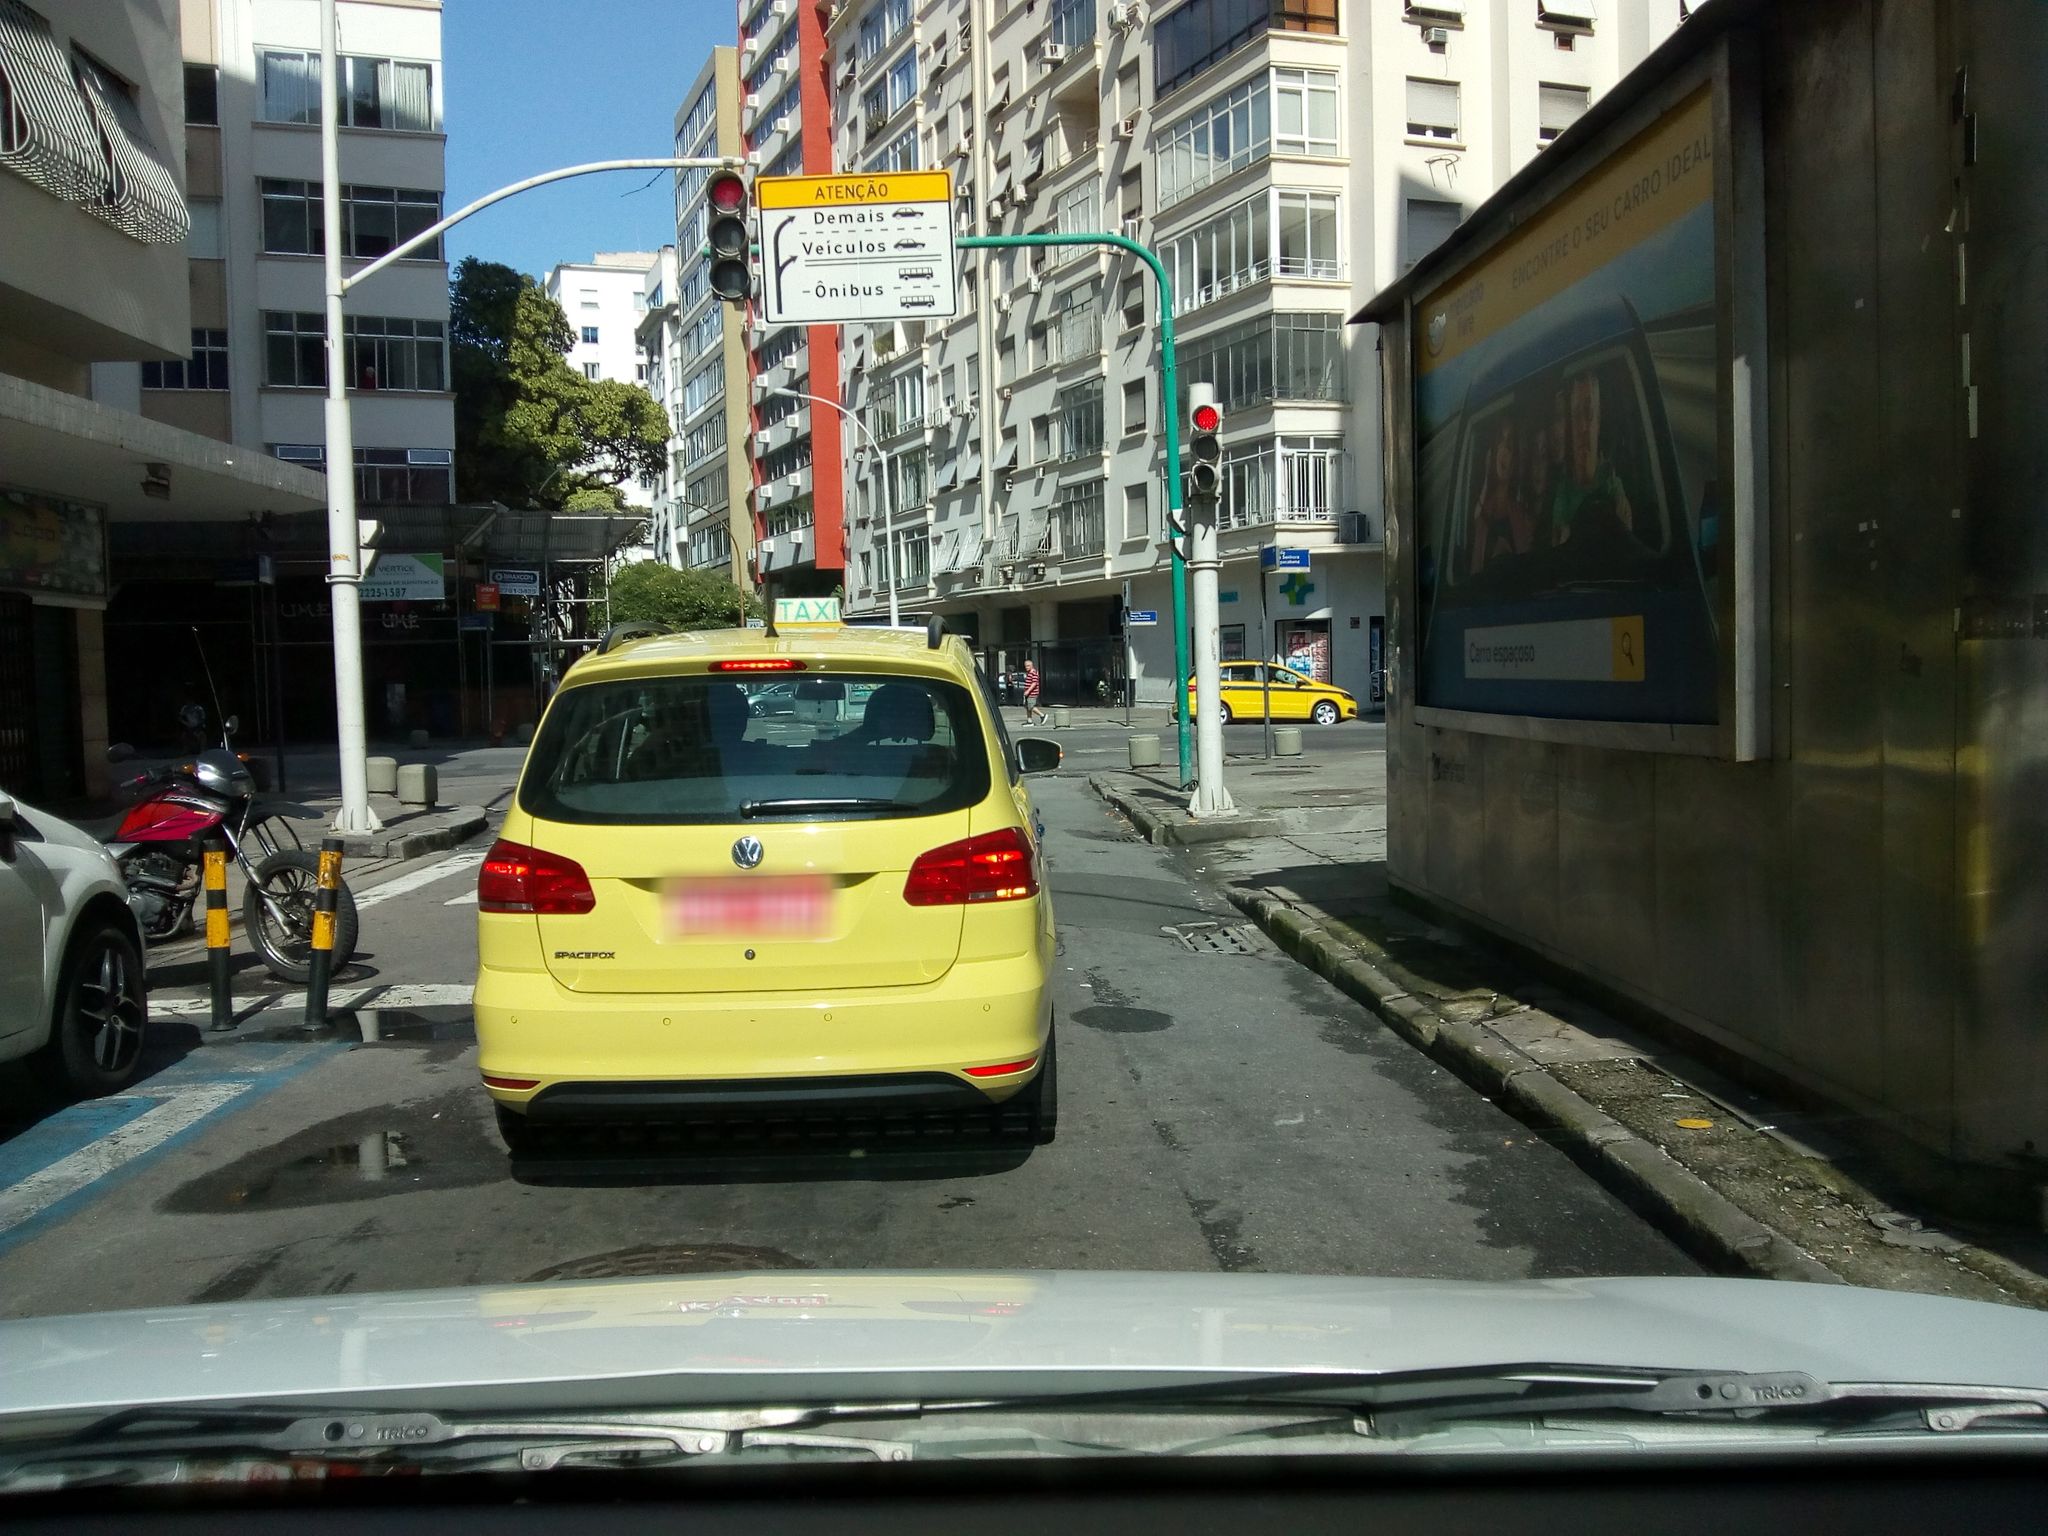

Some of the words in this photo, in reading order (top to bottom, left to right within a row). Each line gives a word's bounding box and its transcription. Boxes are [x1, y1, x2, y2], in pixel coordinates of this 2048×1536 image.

[815, 179, 889, 202] ATENÇÃO
[814, 209, 885, 225] Demais
[1512, 234, 1569, 289] ENCONTRE
[1573, 225, 1581, 249] O
[1585, 206, 1610, 242] SEU
[1614, 169, 1662, 221] CARRO
[1666, 134, 1712, 186] IDEAL
[802, 239, 886, 256] Veículos
[815, 280, 884, 298] Ônibus
[777, 601, 837, 621] TAXI
[1493, 645, 1535, 668] espaçoso
[554, 951, 616, 960] SPACEFOX
[376, 1425, 428, 1441] TRICO
